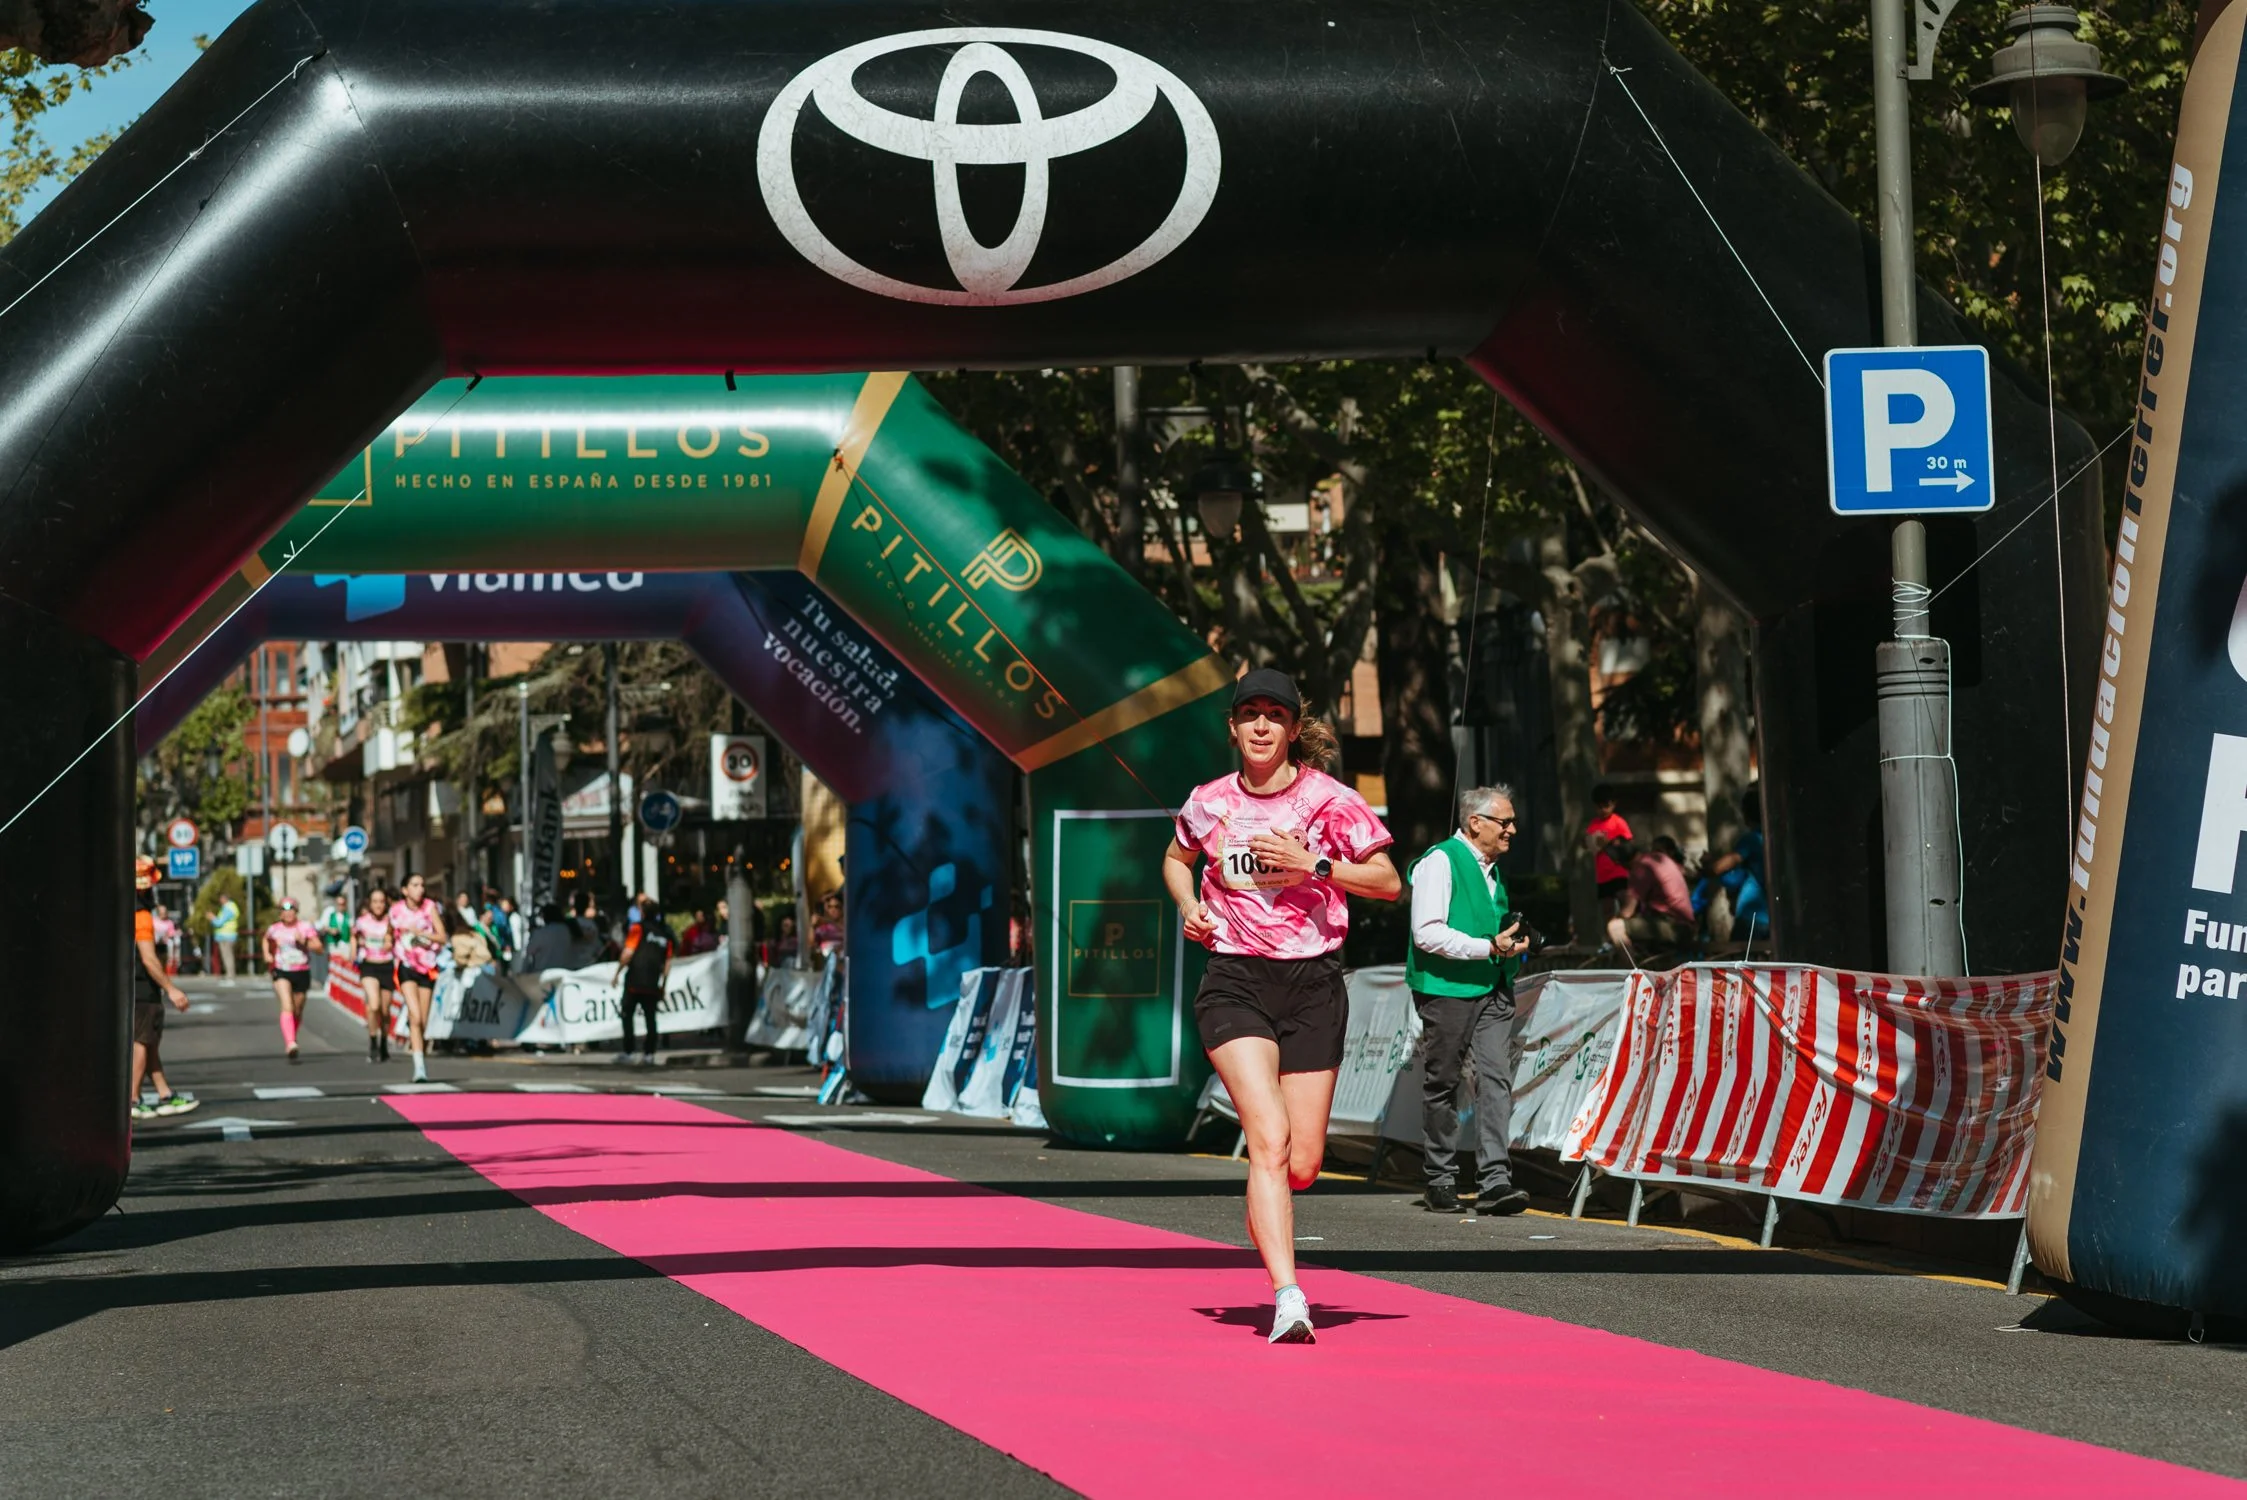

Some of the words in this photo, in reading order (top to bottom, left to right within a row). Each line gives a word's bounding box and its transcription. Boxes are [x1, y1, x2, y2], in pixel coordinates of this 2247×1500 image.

[395, 474, 472, 489] HECHO
[487, 474, 514, 489] EN
[529, 471, 619, 489] ESPAÑA
[634, 474, 708, 489] DESDE
[723, 473, 771, 488] 1981
[1862, 368, 1956, 492] P
[1926, 456, 1948, 470] 30
[1953, 457, 1967, 469] m
[801, 593, 832, 633] Tu
[831, 629, 899, 700] salud,
[851, 504, 1063, 720] PITILLOS
[763, 631, 862, 734] vocación.
[782, 617, 882, 714] nuestra
[1073, 947, 1155, 960] PITILLOS
